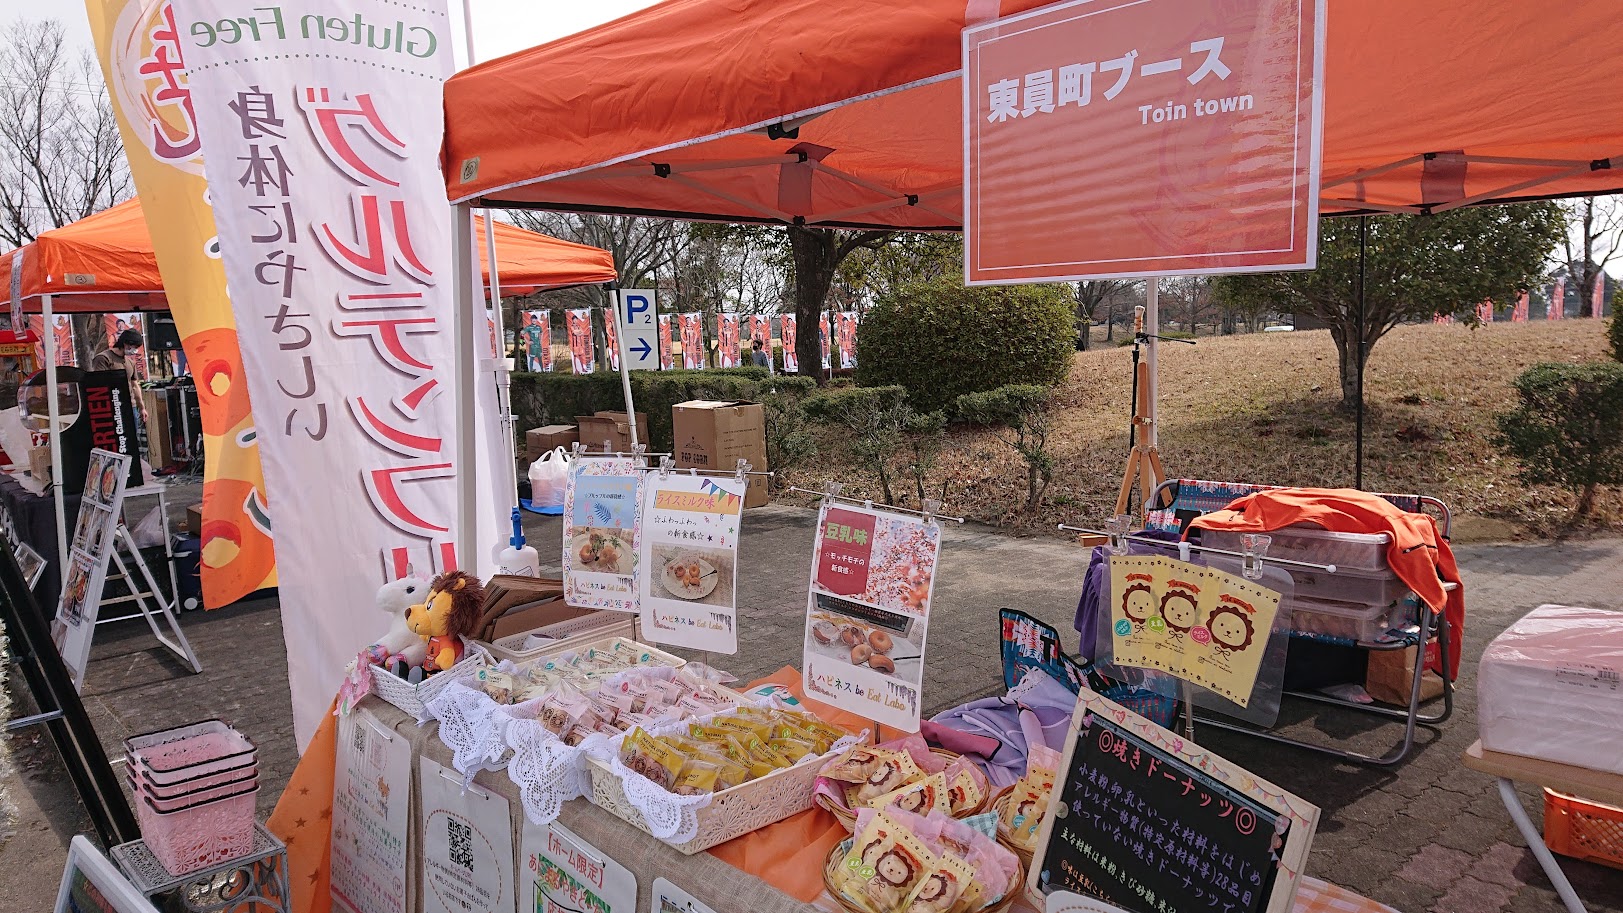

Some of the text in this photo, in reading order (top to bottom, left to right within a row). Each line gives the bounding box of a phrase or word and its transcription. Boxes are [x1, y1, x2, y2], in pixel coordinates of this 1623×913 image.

[986, 36, 1232, 124] 東員町ブース
[1138, 94, 1254, 125] Toin town
[118, 435, 127, 454] Stop
[656, 493, 716, 510] ライスミルク味
[824, 522, 868, 547] 豆乳味
[688, 618, 695, 626] be
[696, 619, 707, 628] Eat
[708, 621, 724, 631] Labo
[817, 674, 852, 693] ハピネス
[854, 684, 865, 696] be
[867, 688, 882, 703] Eat
[884, 695, 906, 711] Labo
[1072, 800, 1246, 913] 使っていない焼きドーナッツで
